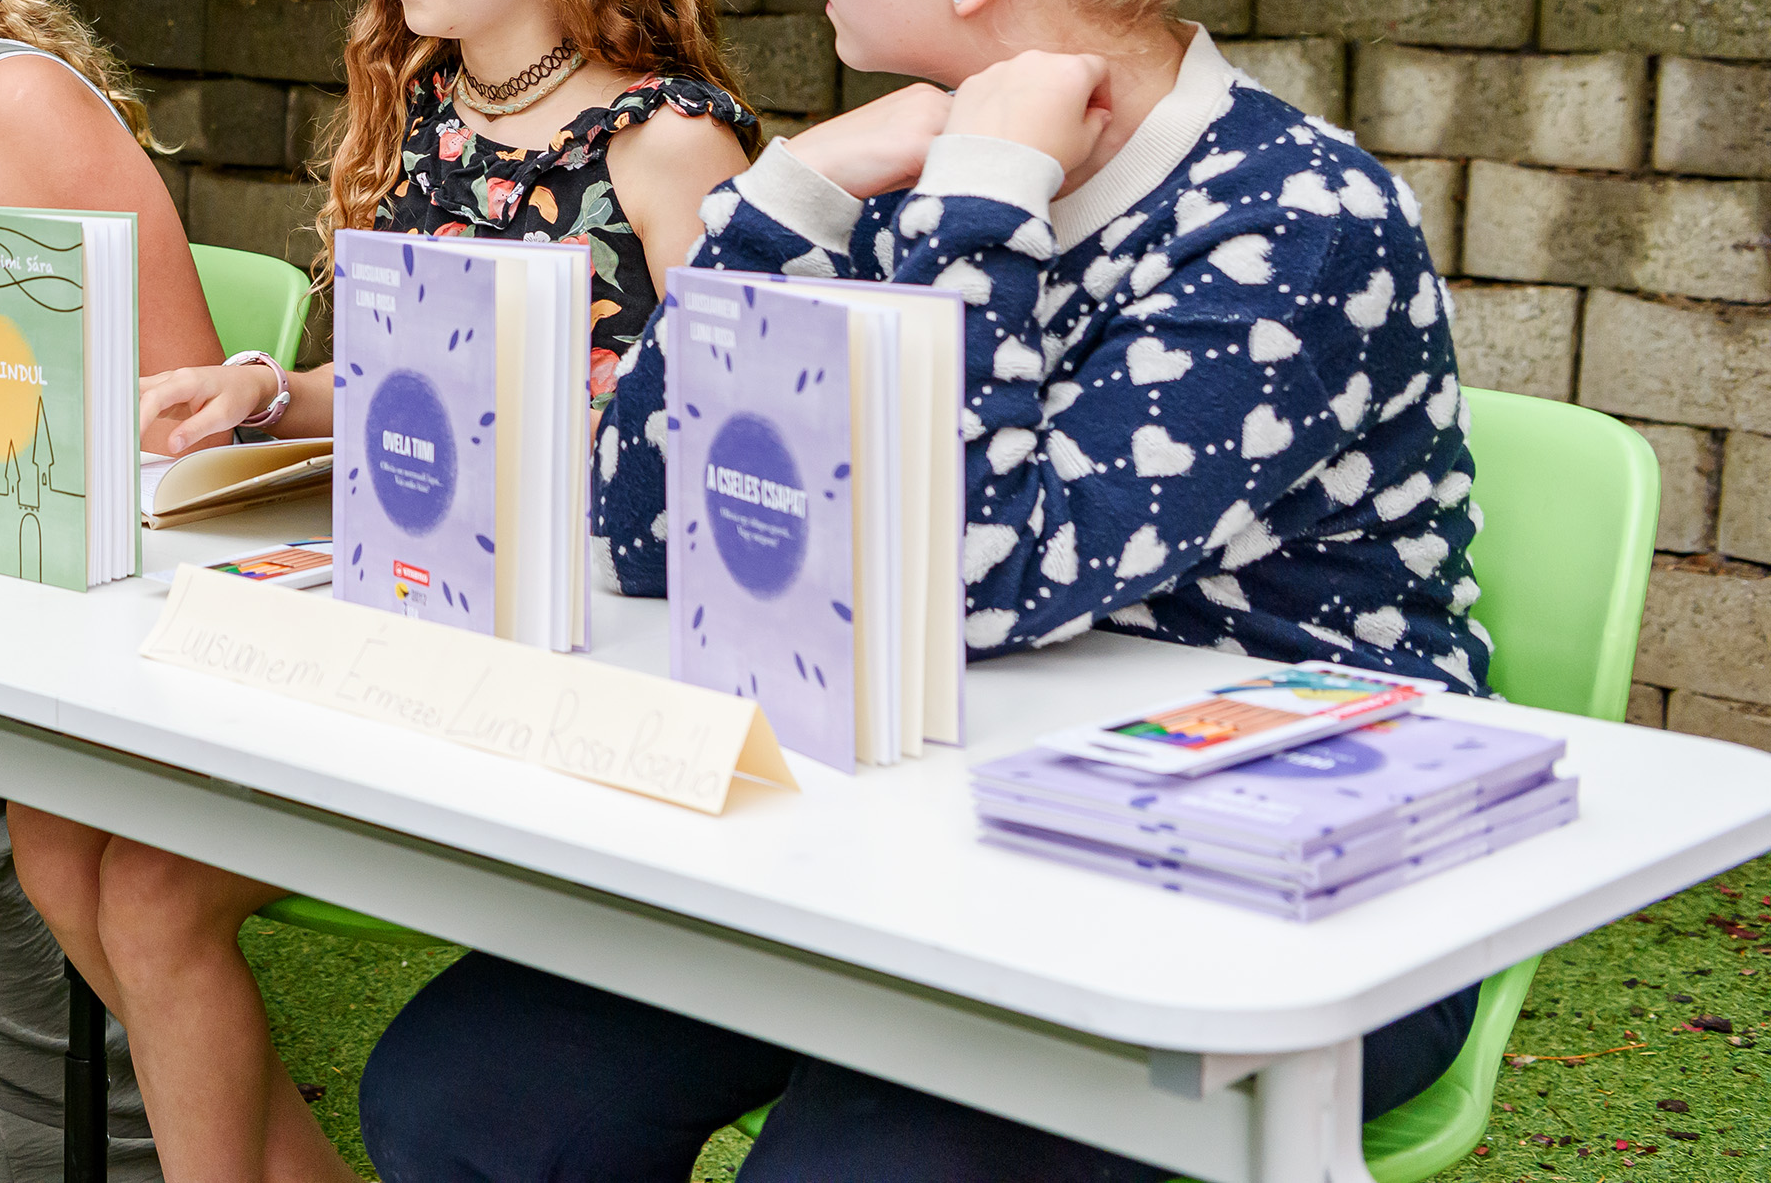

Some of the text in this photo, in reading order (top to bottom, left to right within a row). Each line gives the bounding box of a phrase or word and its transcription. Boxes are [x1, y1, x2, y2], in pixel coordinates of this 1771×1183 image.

[26, 255, 55, 275] Sára
[706, 463, 717, 492] A
[716, 465, 760, 505] CSELES
